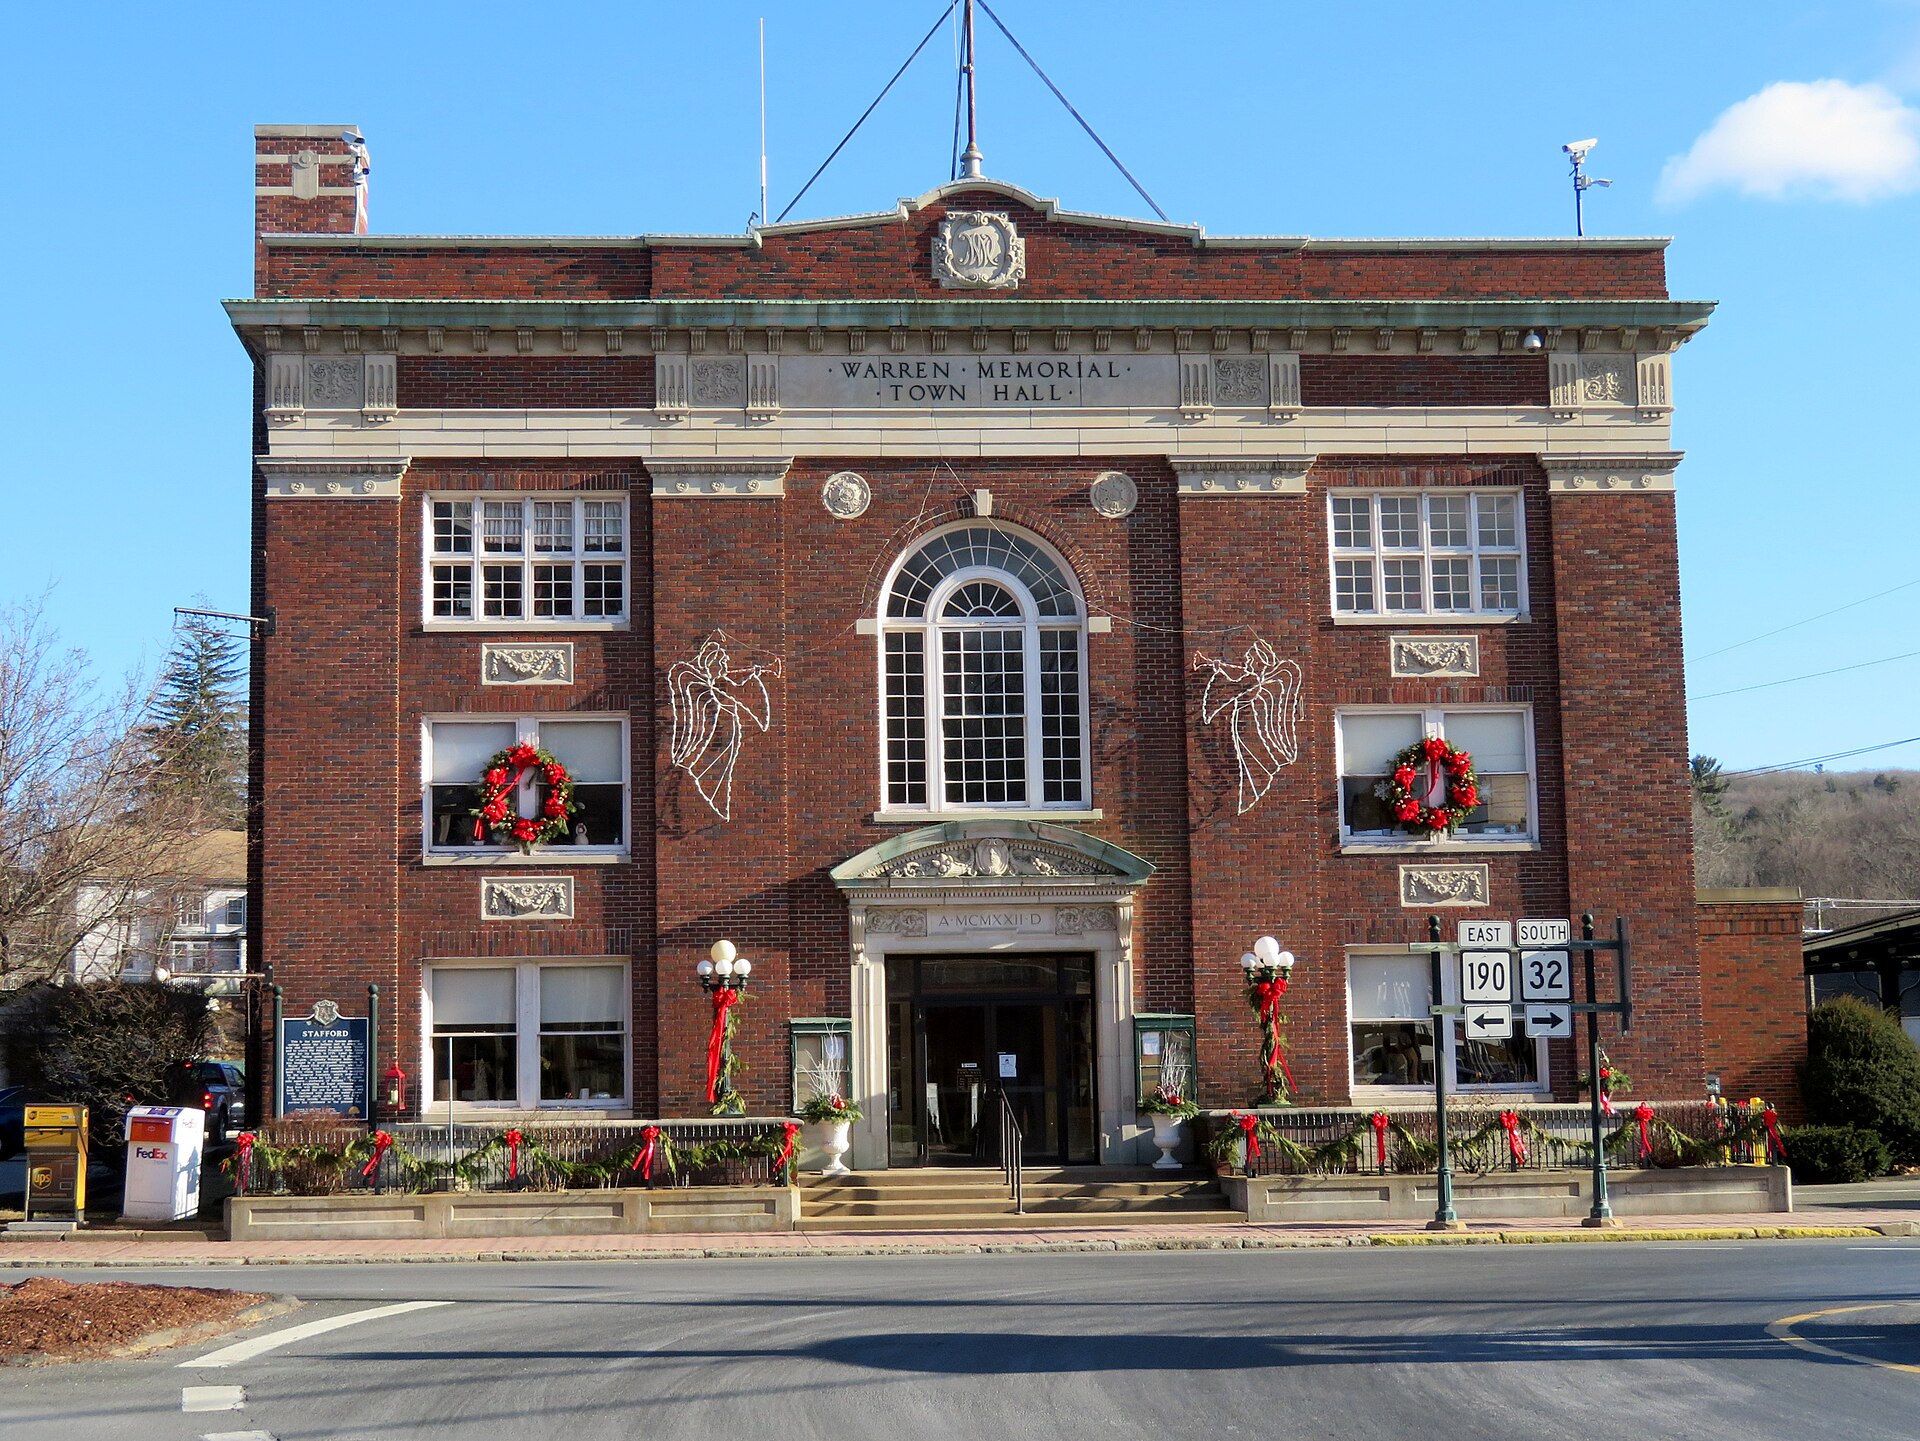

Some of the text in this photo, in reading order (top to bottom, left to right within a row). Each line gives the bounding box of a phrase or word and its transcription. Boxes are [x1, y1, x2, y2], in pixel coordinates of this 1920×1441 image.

[841, 361, 1120, 379] WARREN MEMORIAL
[891, 384, 1062, 401] TOWN HALL
[1468, 927, 1501, 942] EAST
[1520, 925, 1567, 940] SOUTH
[1468, 962, 1505, 991] 190
[1529, 960, 1563, 989] 32
[302, 1030, 349, 1038] STAFFORD
[136, 1147, 168, 1159] FedEx
